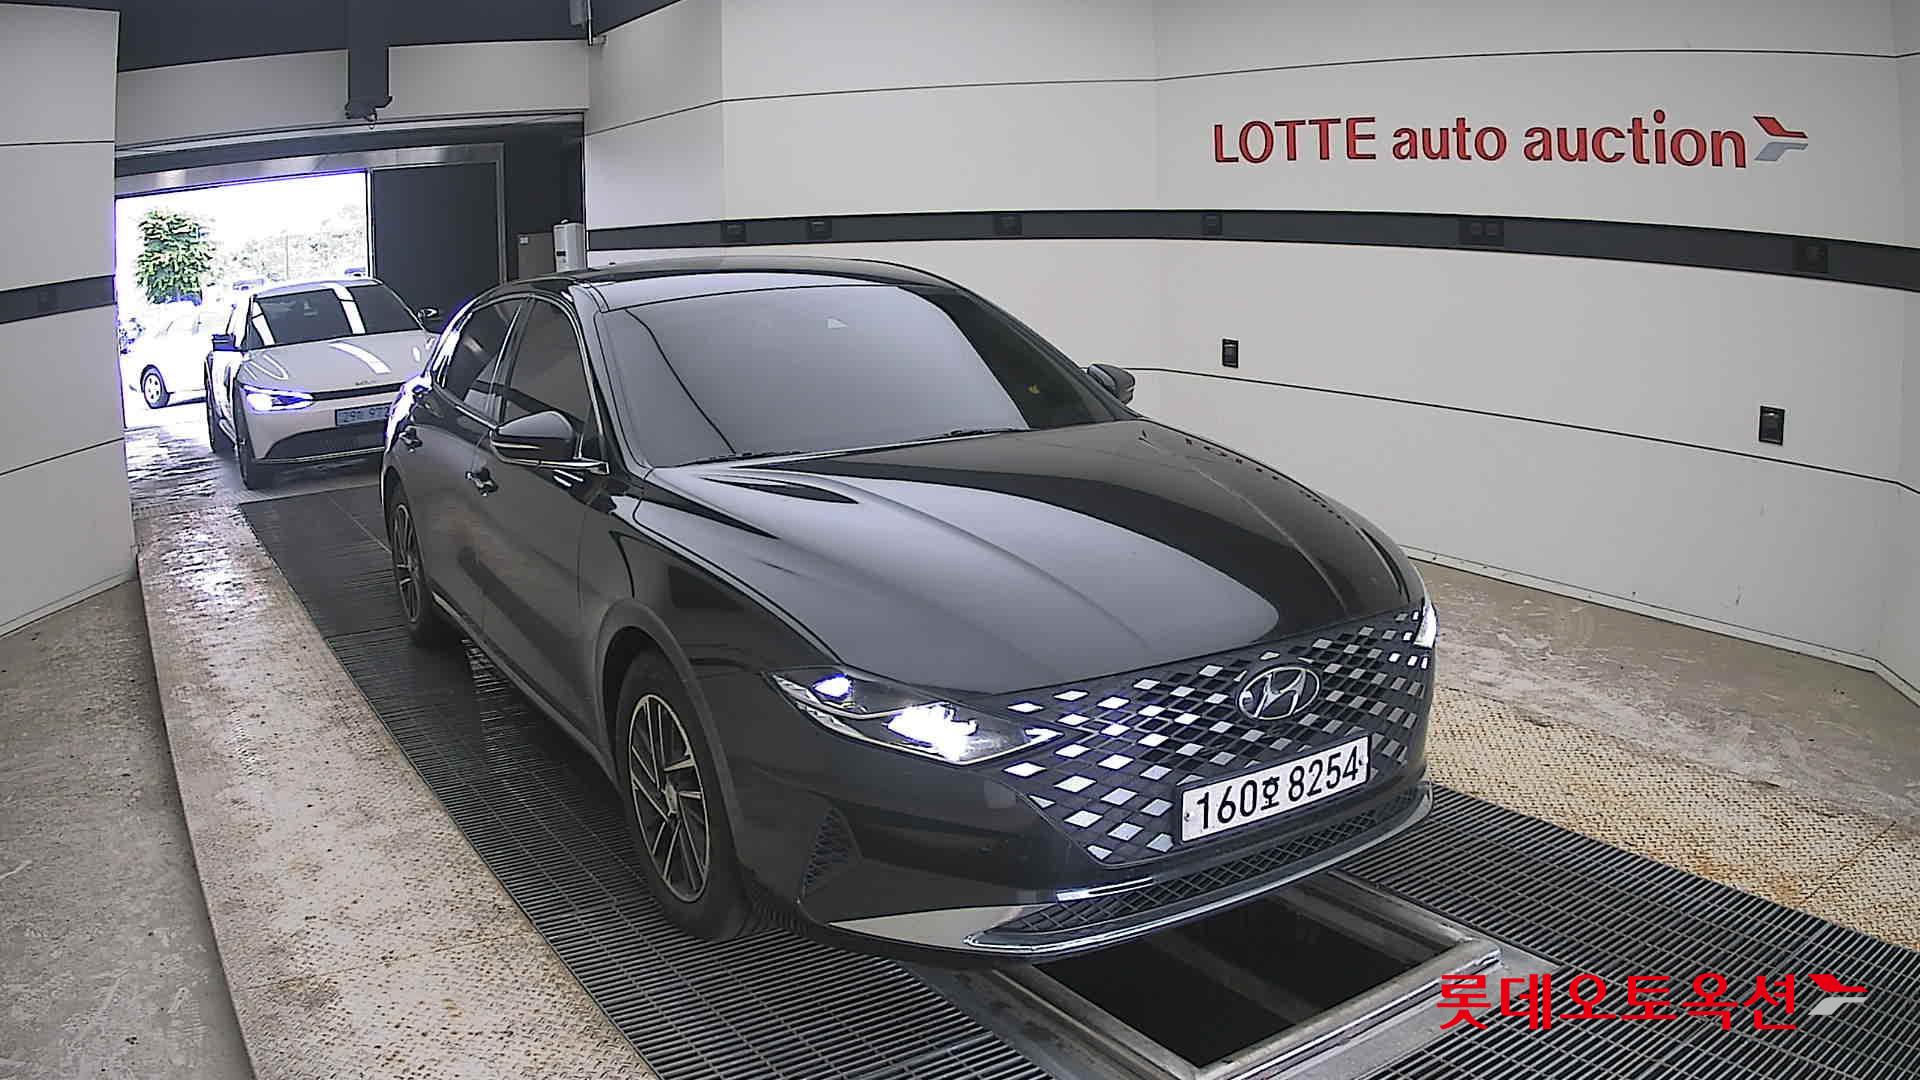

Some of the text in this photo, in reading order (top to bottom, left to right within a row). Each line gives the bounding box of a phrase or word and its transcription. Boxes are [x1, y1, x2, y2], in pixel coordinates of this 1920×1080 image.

[1213, 108, 1748, 169] LOTTE auto auction
[1196, 745, 1360, 830] 160호 8254
